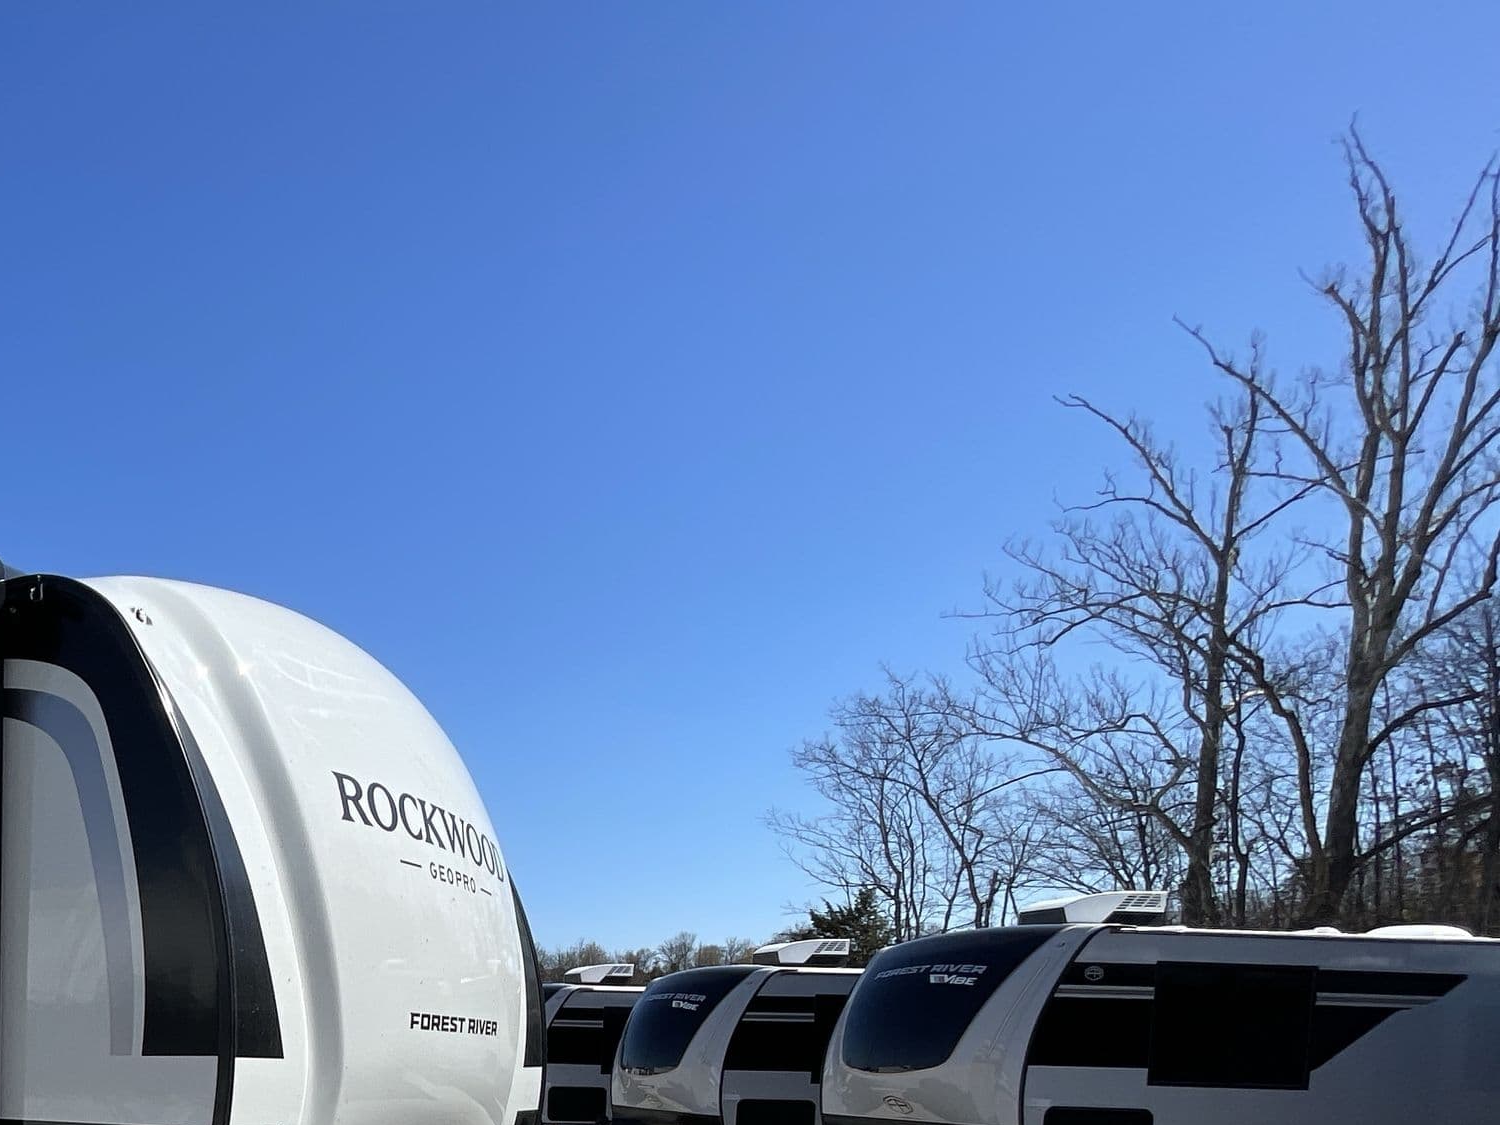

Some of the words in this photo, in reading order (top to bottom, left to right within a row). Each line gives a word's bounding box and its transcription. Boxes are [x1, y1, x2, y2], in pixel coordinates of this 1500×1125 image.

[332, 770, 504, 882] ROCKWOOD
[429, 862, 477, 893] GEOPRO
[875, 965, 930, 980] FOREST
[930, 964, 988, 974] RIVER
[410, 1012, 466, 1033] FOREST
[468, 1019, 498, 1036] RIVER
